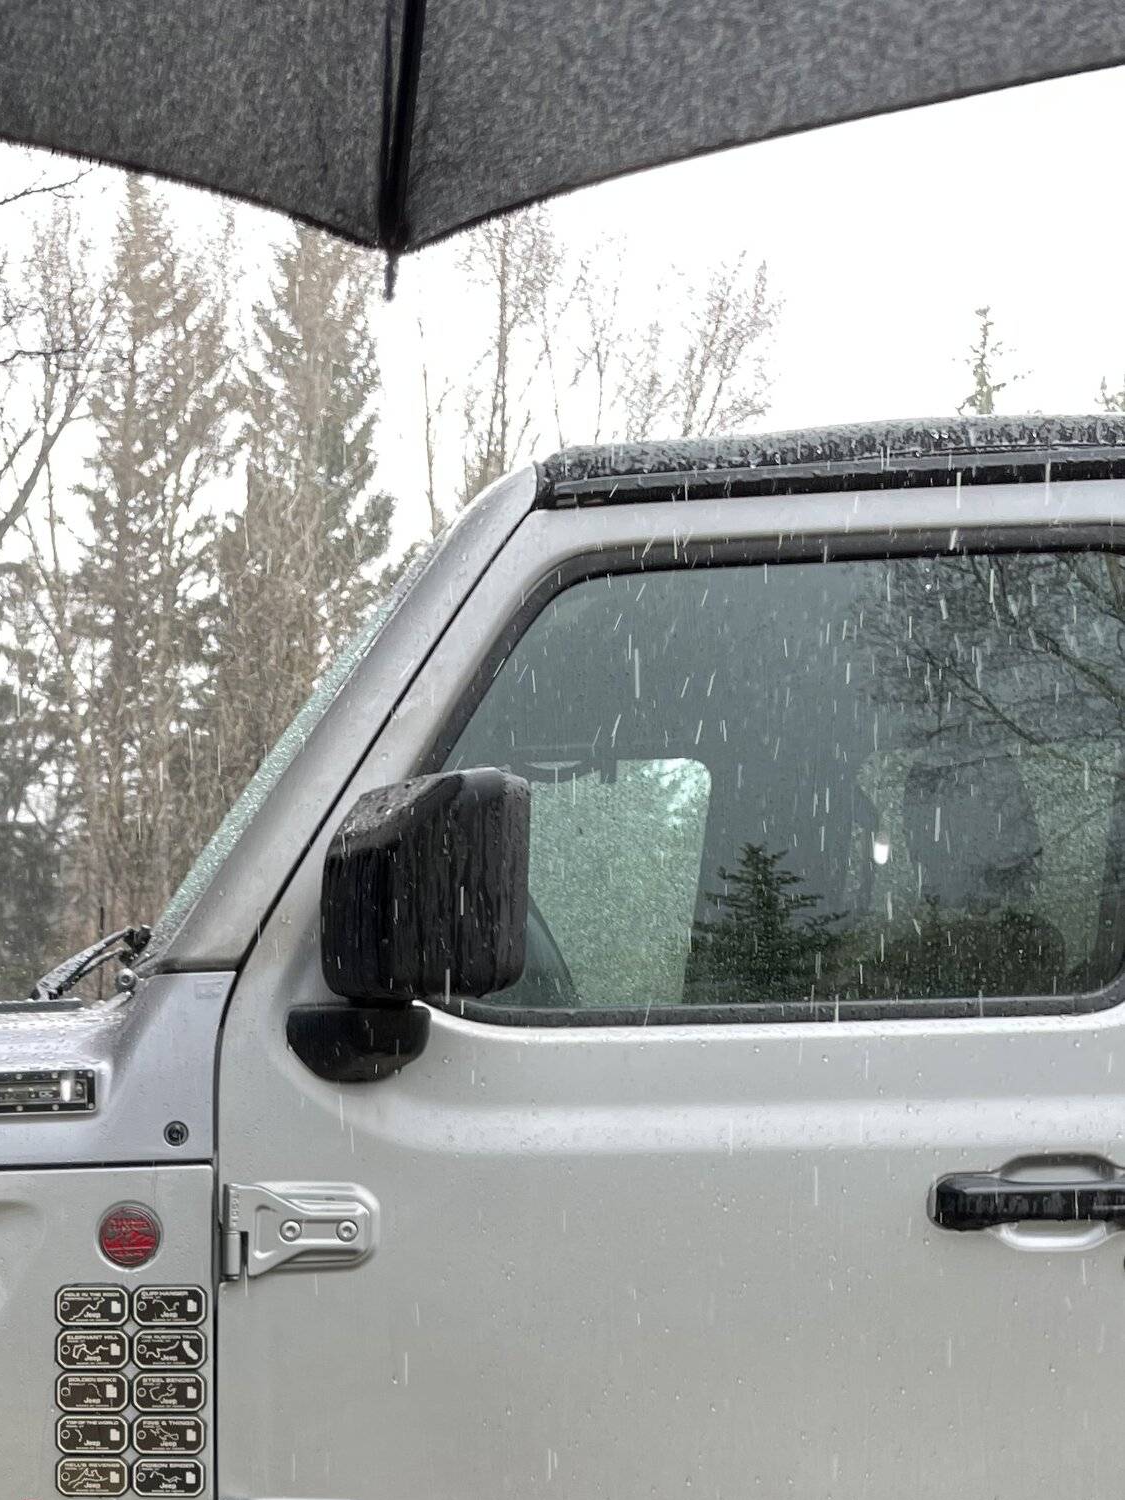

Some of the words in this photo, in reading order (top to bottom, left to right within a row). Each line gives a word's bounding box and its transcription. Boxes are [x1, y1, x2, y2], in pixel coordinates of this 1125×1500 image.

[160, 1397, 178, 1405] Jeep
[83, 1439, 101, 1447] Jeep
[83, 1481, 101, 1489] Jeep
[159, 1482, 177, 1490] Jeep
